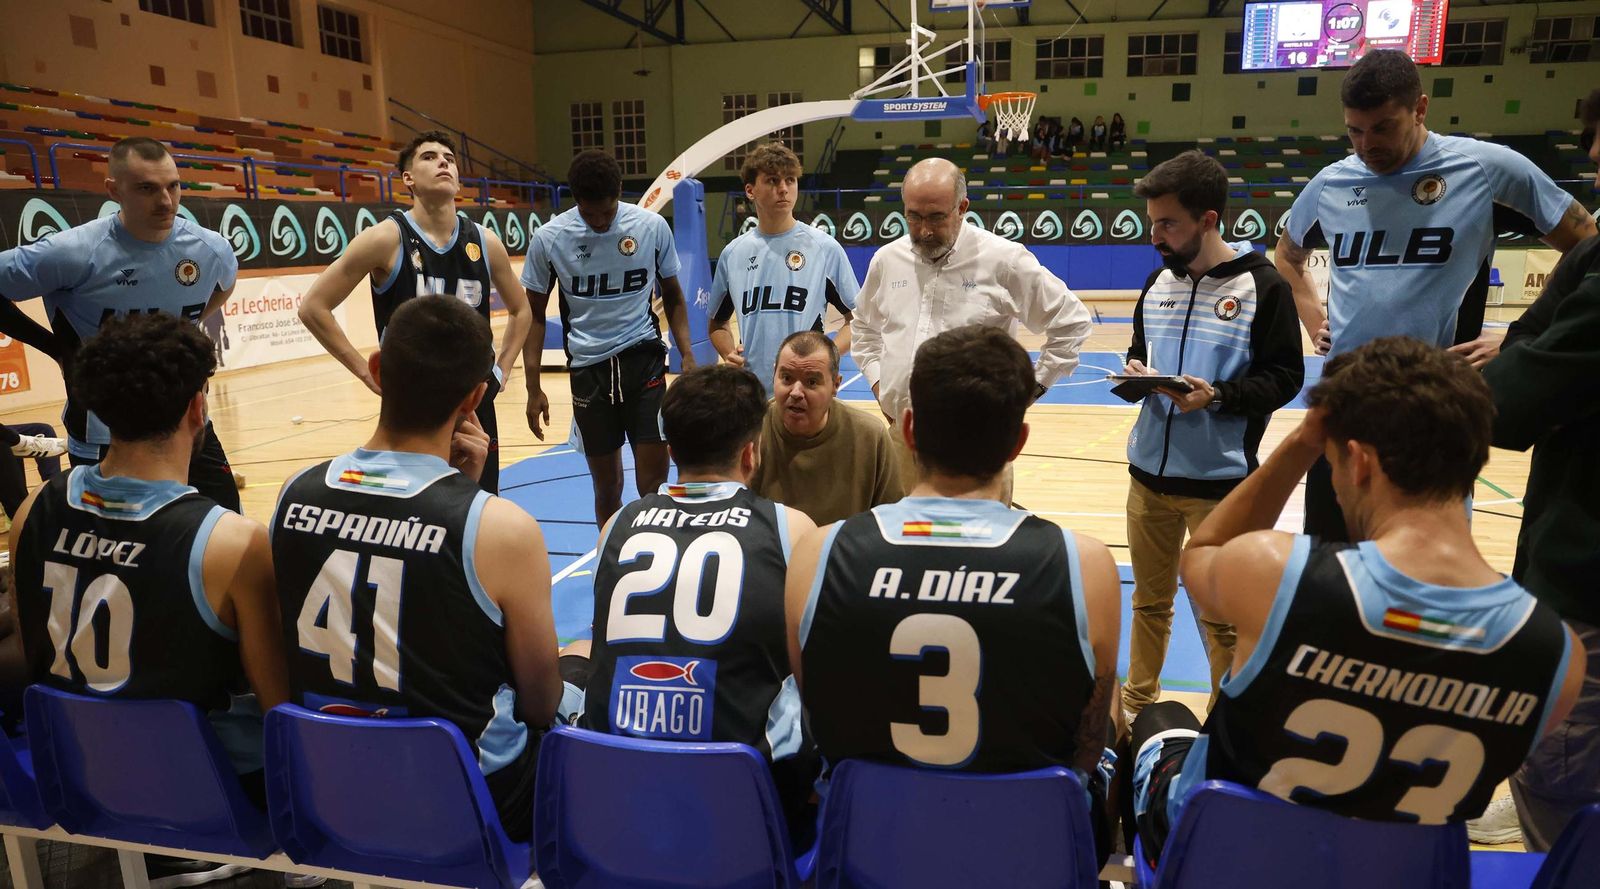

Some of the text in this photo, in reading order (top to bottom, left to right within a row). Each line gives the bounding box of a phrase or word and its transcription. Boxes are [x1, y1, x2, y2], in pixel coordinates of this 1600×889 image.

[1328, 16, 1360, 30] 1:07
[1288, 51, 1307, 65] 16
[1347, 198, 1368, 206] vive
[1333, 227, 1455, 268] ULB
[571, 267, 648, 297] ULB
[741, 285, 808, 316] ULB
[224, 300, 238, 316] La
[283, 502, 447, 554] ESPADIÑA
[630, 507, 751, 529] MATEOS
[53, 527, 146, 568] LÓPEZ
[606, 531, 744, 645] 20
[868, 565, 1020, 604] A. DÍAZ
[42, 560, 134, 692] 10
[297, 549, 405, 692] 41
[889, 613, 983, 768] 3
[1286, 644, 1539, 726] CHERNODOLIA
[615, 690, 704, 735] UBAGO
